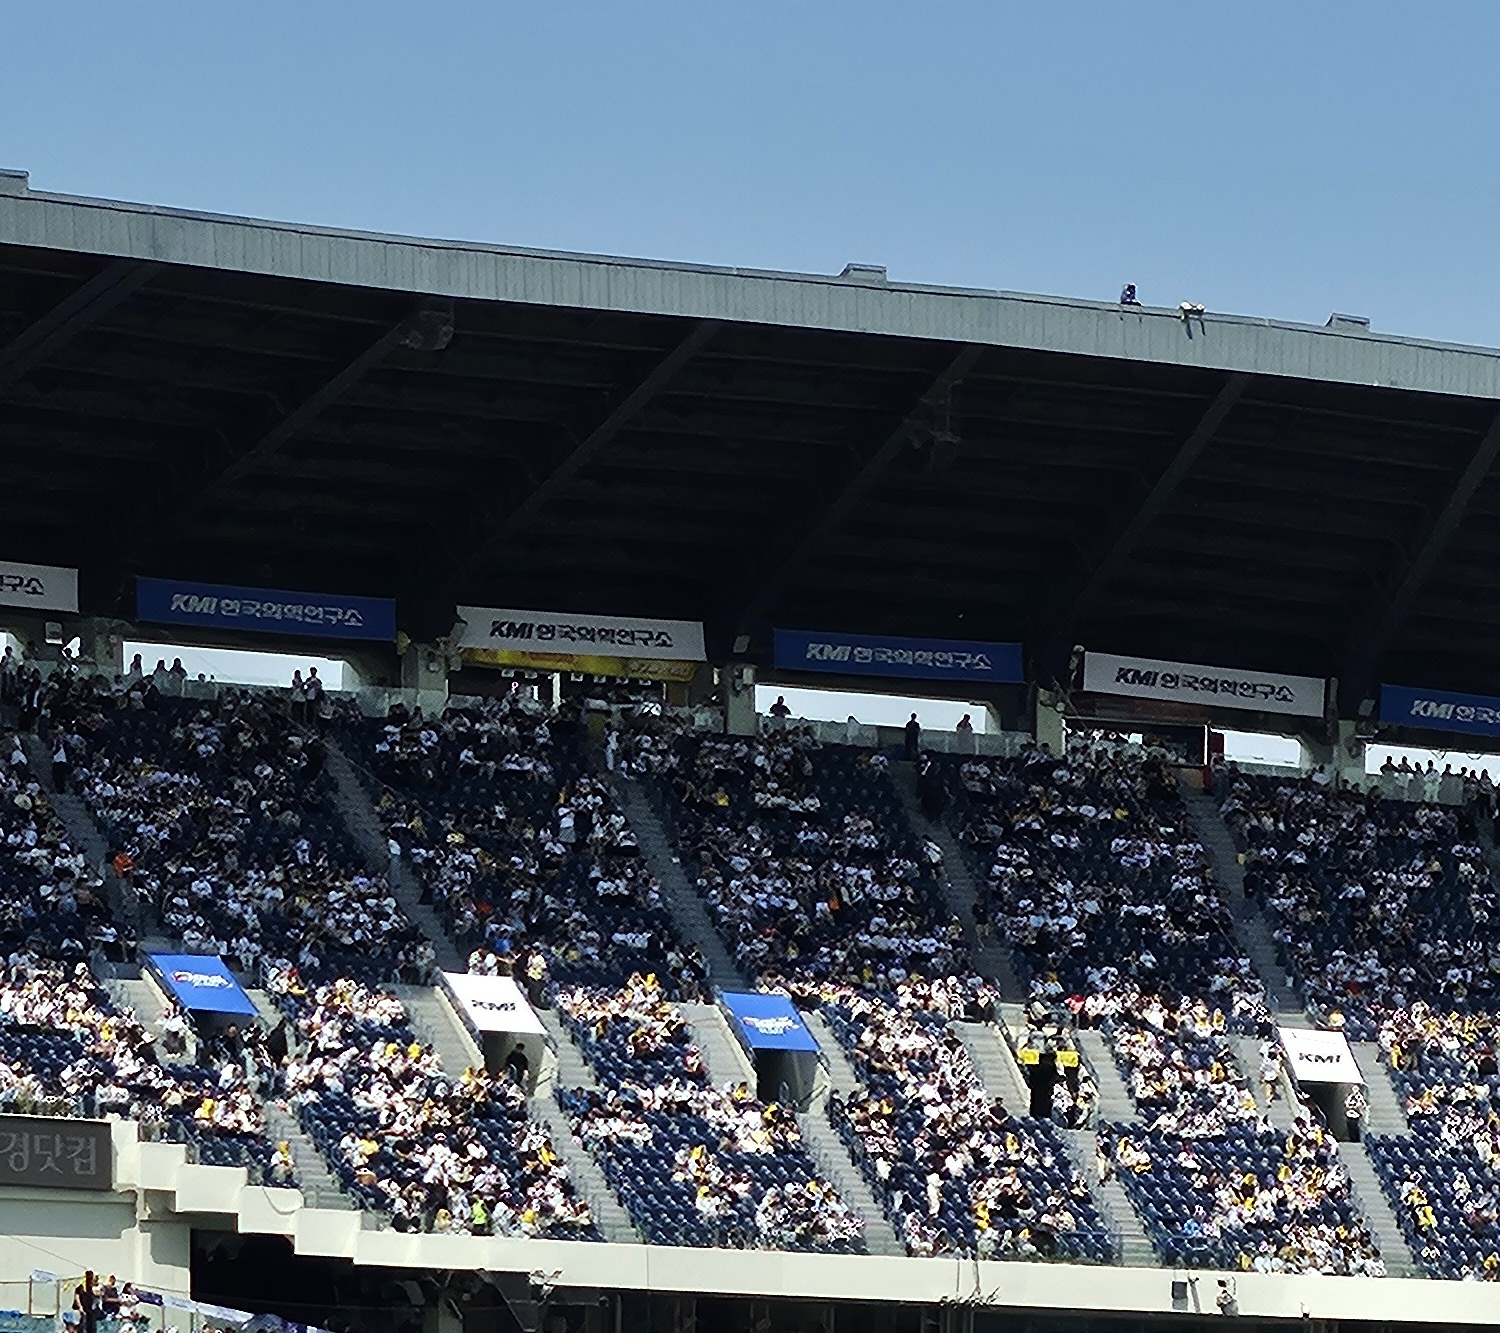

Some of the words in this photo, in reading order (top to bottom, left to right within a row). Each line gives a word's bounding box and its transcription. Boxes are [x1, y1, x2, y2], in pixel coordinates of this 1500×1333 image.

[170, 594, 216, 613] KMI
[490, 620, 533, 640] KMI
[806, 643, 851, 662] KMI
[1115, 667, 1159, 687] KMI
[1410, 699, 1454, 719] KMI
